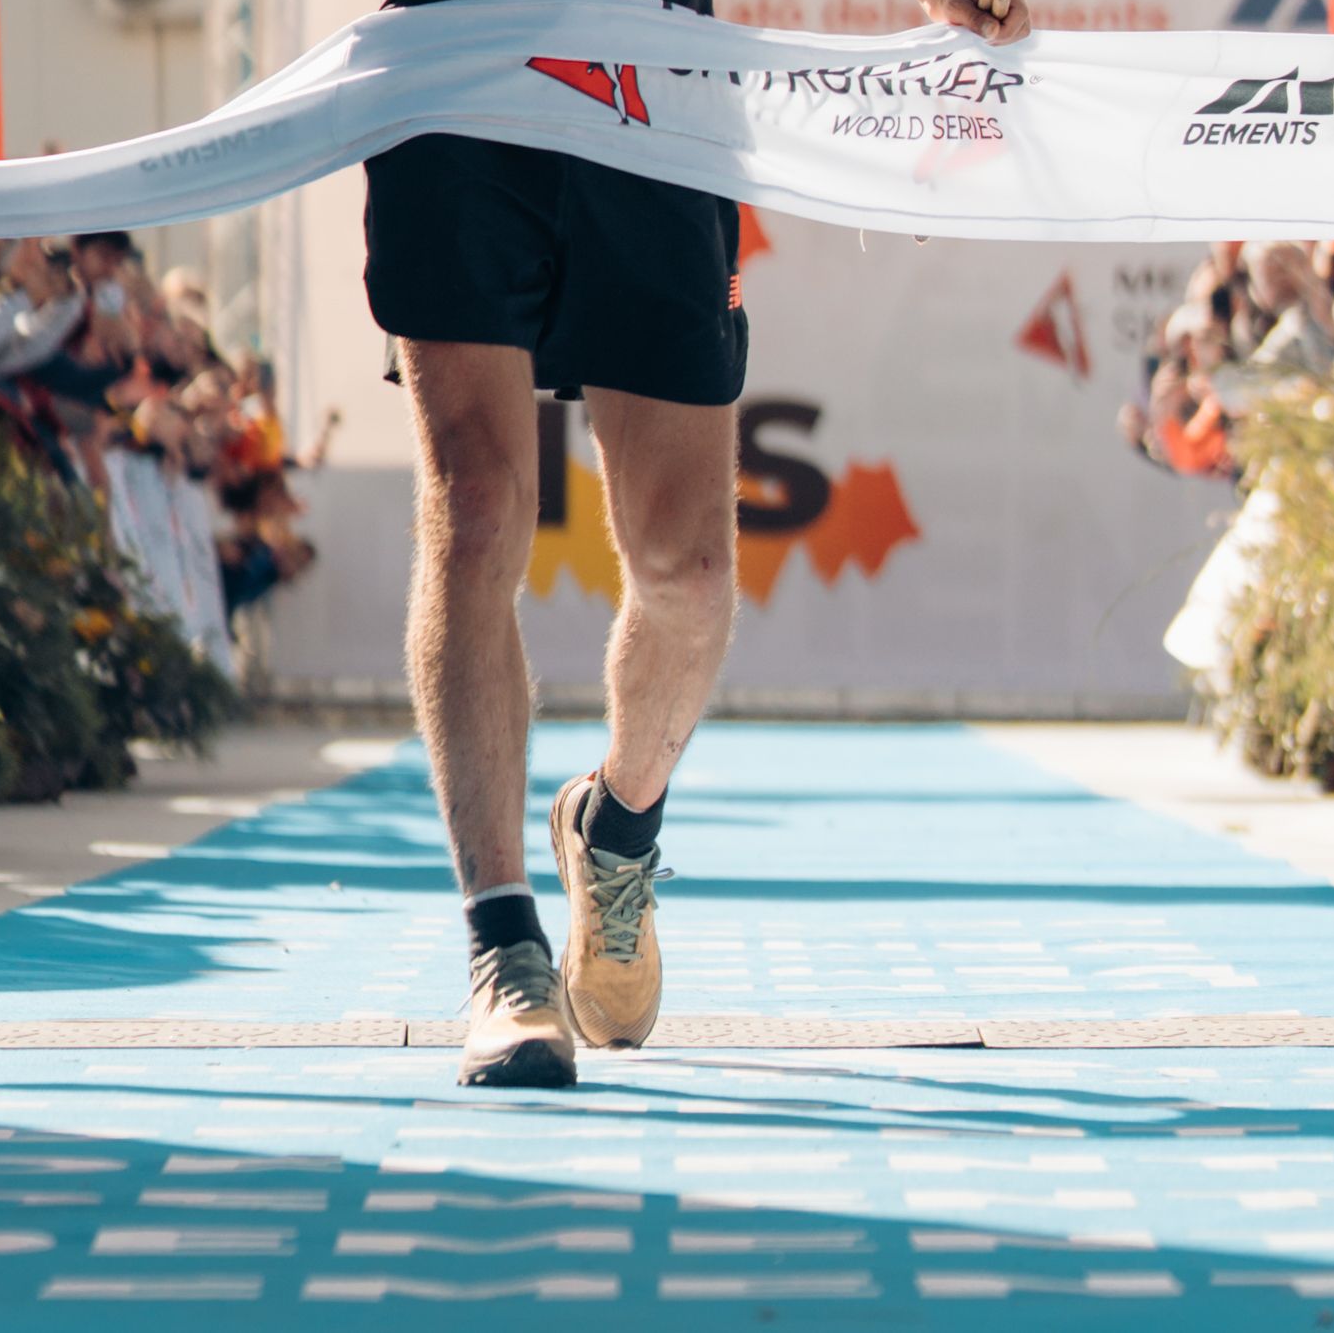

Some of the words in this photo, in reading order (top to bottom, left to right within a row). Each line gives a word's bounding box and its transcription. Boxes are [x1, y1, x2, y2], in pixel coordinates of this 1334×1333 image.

[832, 114, 924, 141] WORLD
[931, 113, 1005, 141] SERIES
[1183, 121, 1320, 146] DEMENTS
